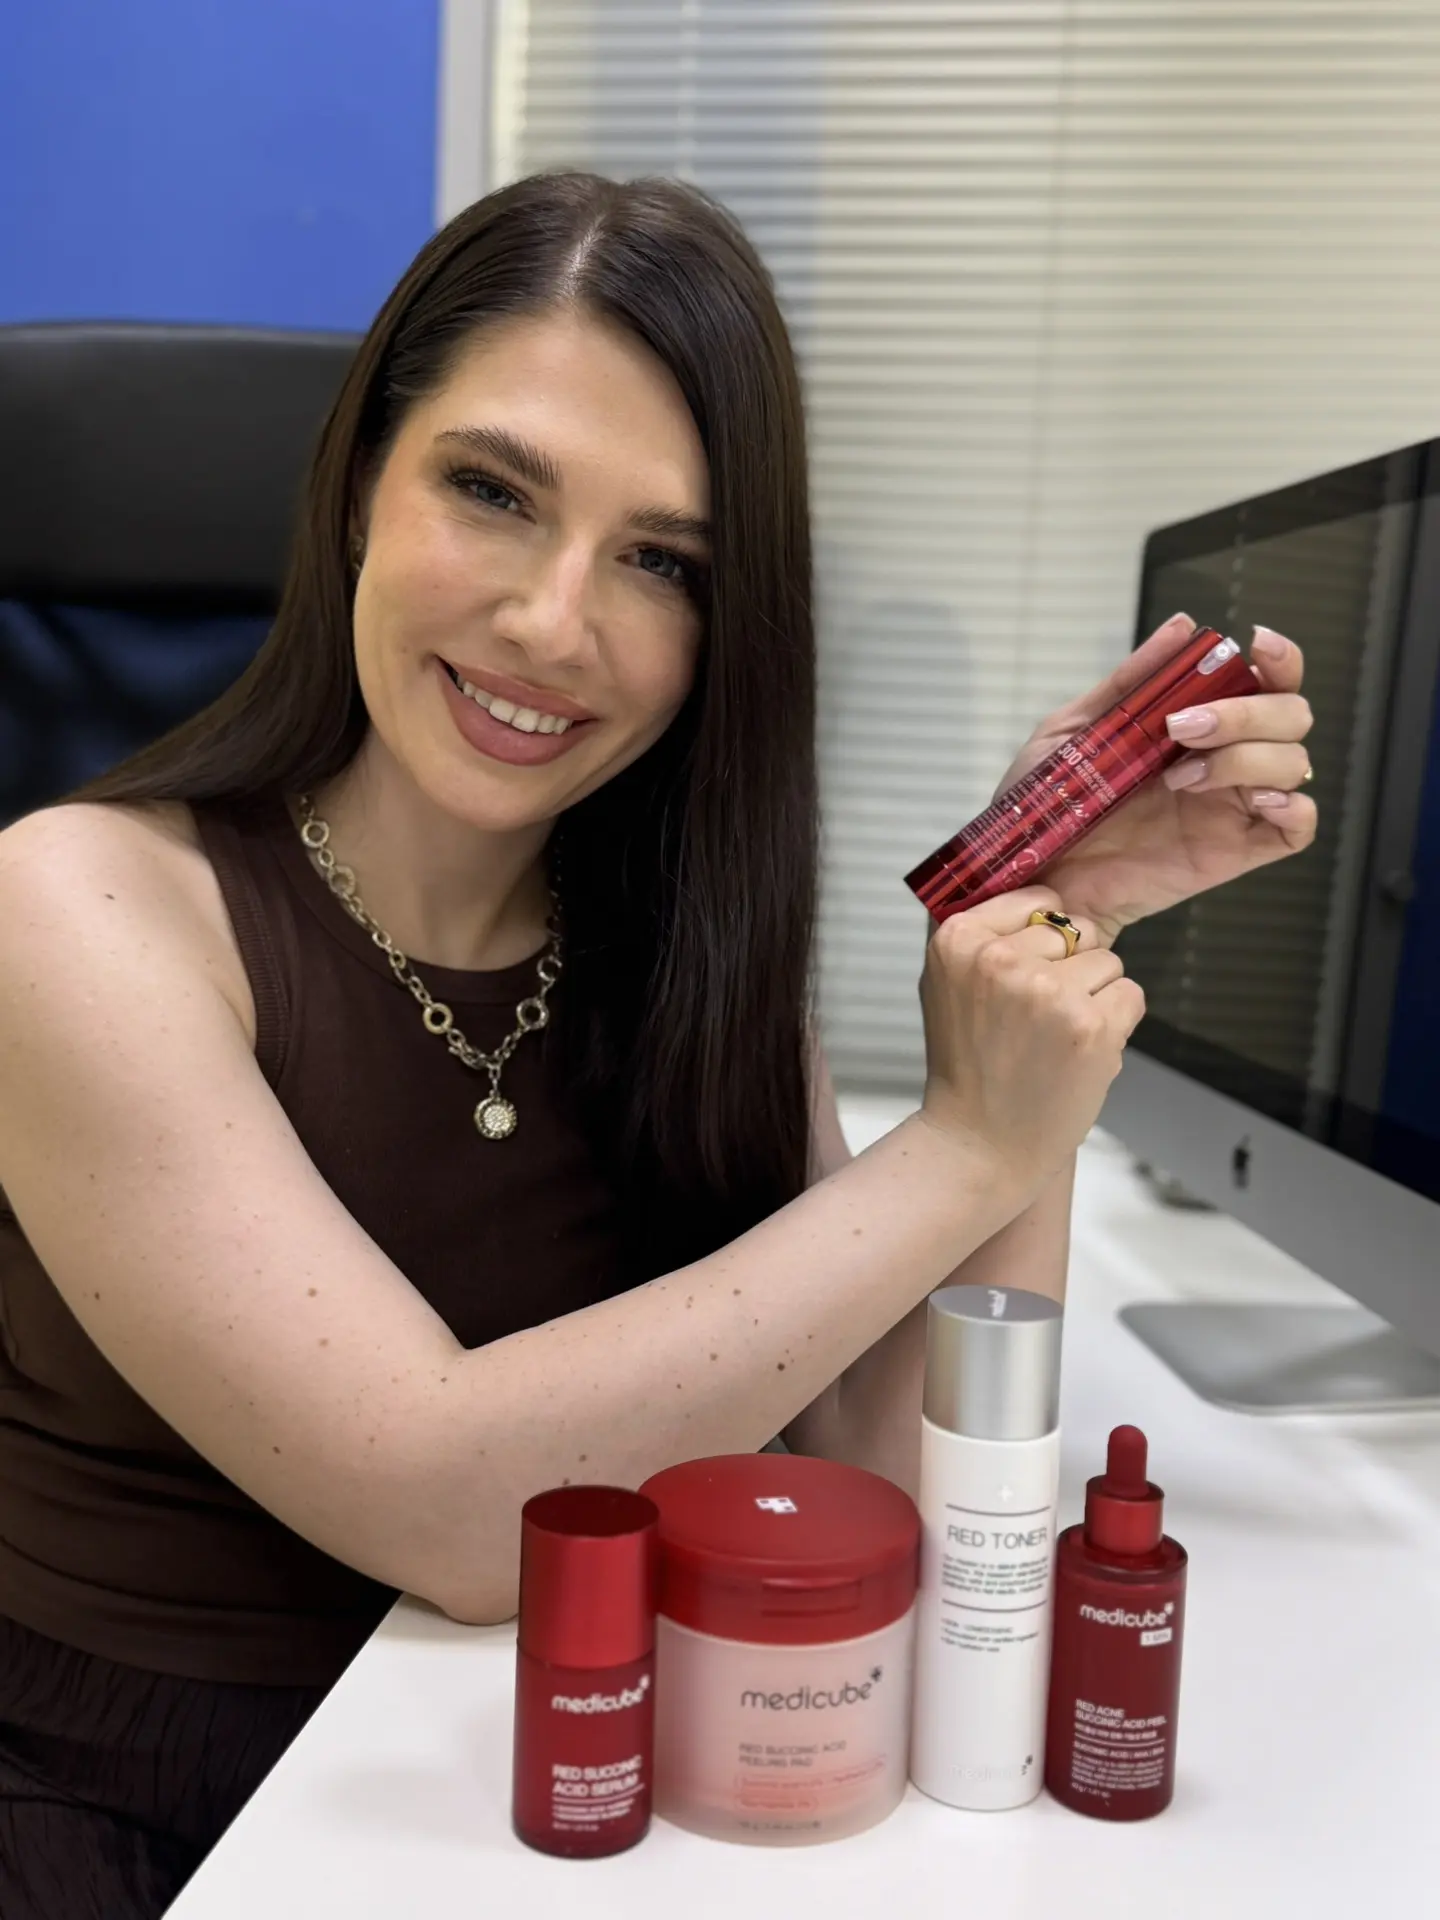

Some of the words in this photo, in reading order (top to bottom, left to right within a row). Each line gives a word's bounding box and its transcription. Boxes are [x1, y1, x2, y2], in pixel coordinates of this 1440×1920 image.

[1057, 740, 1084, 768] 300
[1080, 758, 1095, 774] RED
[1073, 763, 1099, 791] REEDLE
[947, 1524, 986, 1548] RED
[991, 1527, 1048, 1550] TONER
[1079, 1603, 1166, 1628] medicube
[551, 1687, 645, 1715] medicube
[740, 1681, 873, 1711] medicube
[1075, 1698, 1096, 1714] RED
[1096, 1705, 1125, 1719] ACNE
[1122, 1718, 1146, 1730] ACID
[552, 1764, 582, 1781] RED
[552, 1781, 590, 1798] ACID
